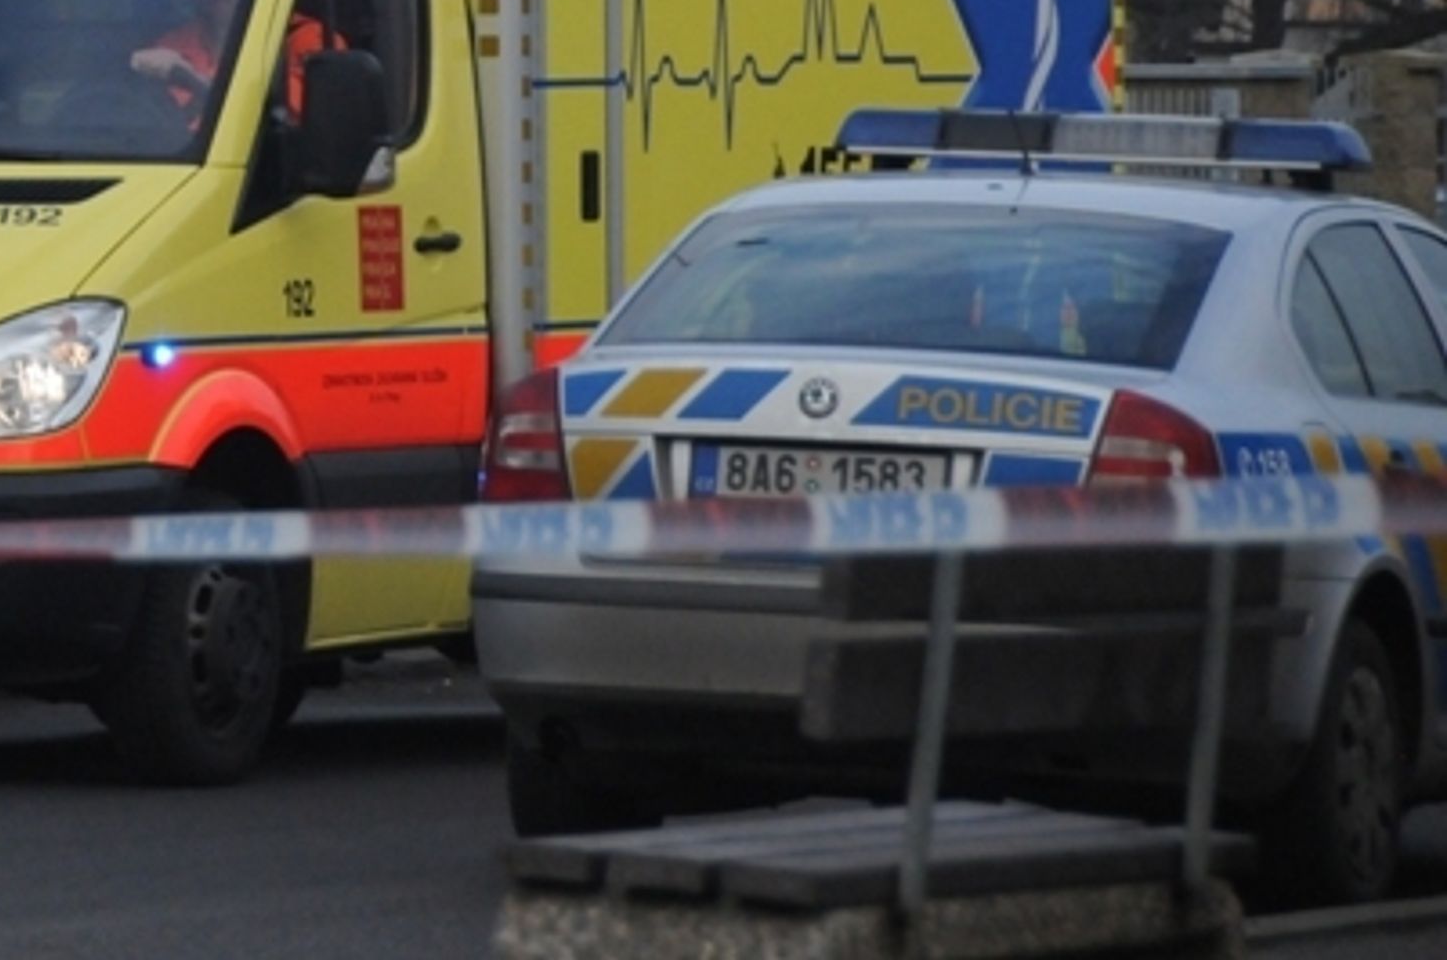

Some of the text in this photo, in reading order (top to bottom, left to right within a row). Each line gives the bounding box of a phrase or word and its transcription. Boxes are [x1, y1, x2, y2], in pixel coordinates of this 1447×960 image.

[283, 278, 315, 318] 192
[898, 386, 1084, 432] POLICIE
[725, 451, 927, 494] 8A6 1583
